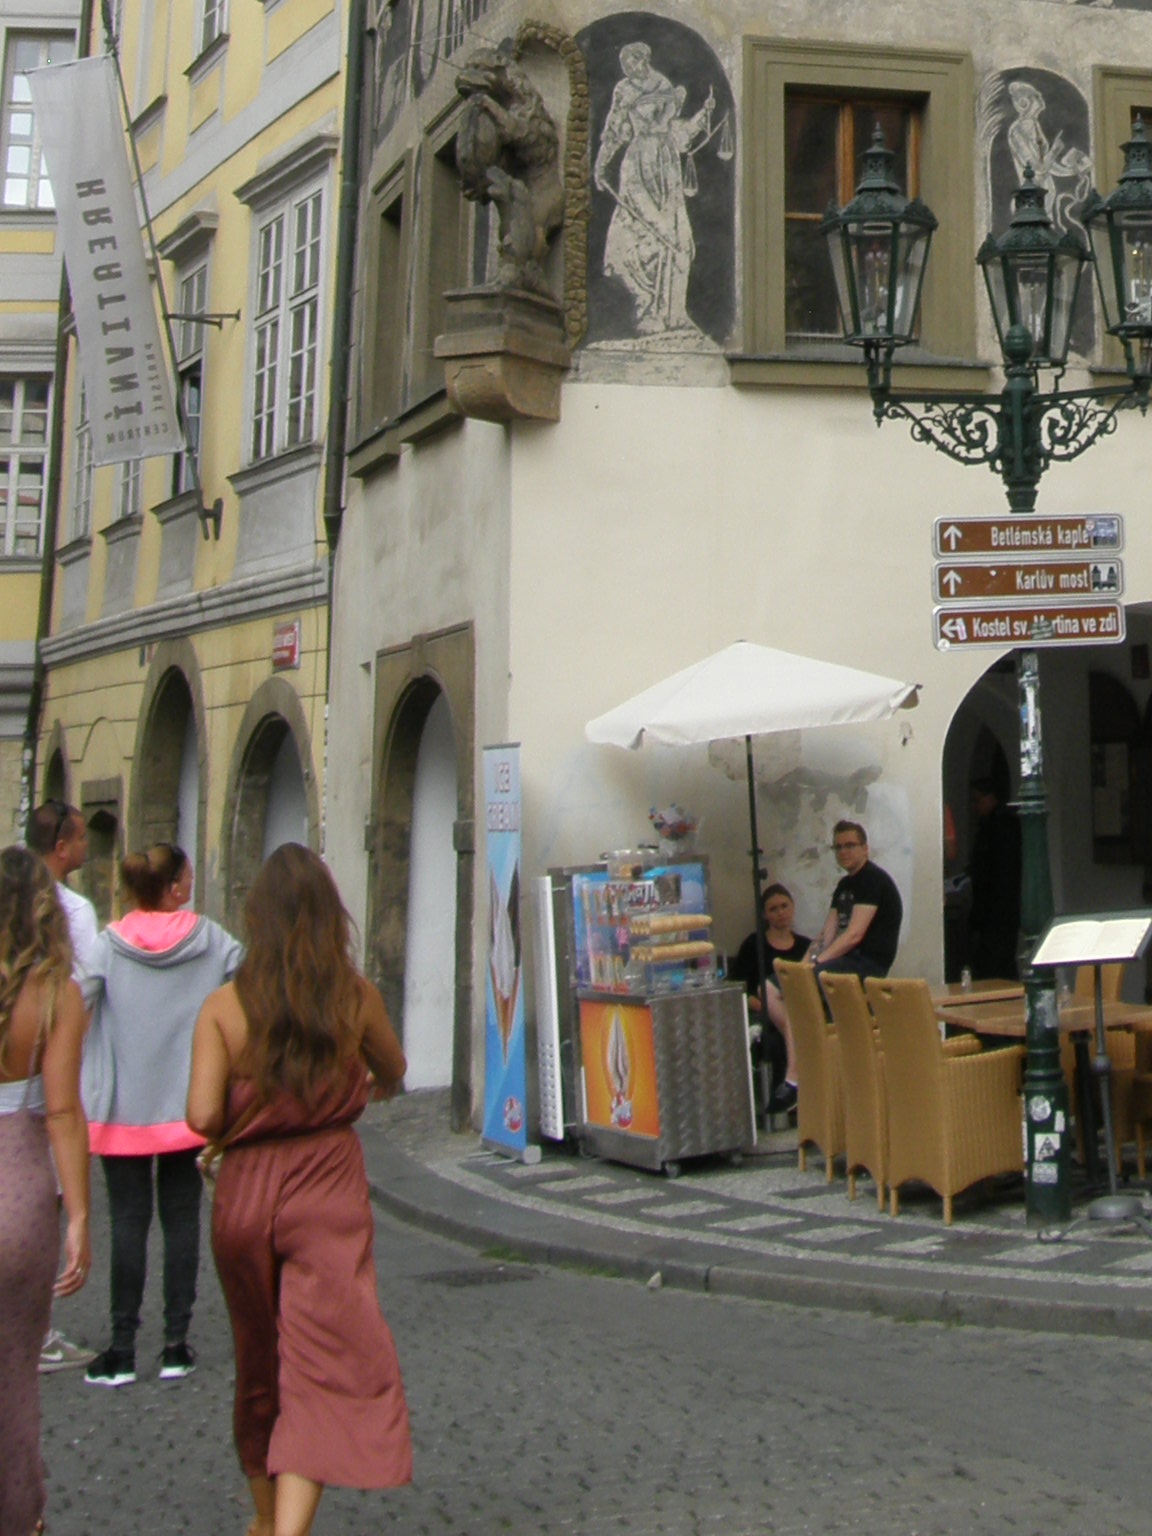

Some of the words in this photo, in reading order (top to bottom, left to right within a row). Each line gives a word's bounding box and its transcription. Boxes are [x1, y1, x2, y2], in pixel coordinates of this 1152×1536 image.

[991, 524, 1053, 547] Betlémská
[1057, 524, 1089, 549] kaple
[1015, 569, 1054, 590] Karlův
[1059, 569, 1088, 589] most
[972, 616, 1011, 638] Kostel
[1013, 621, 1031, 636] sv.
[1033, 613, 1080, 635] rtina
[1081, 618, 1097, 633] ve
[1099, 612, 1117, 632] zdi
